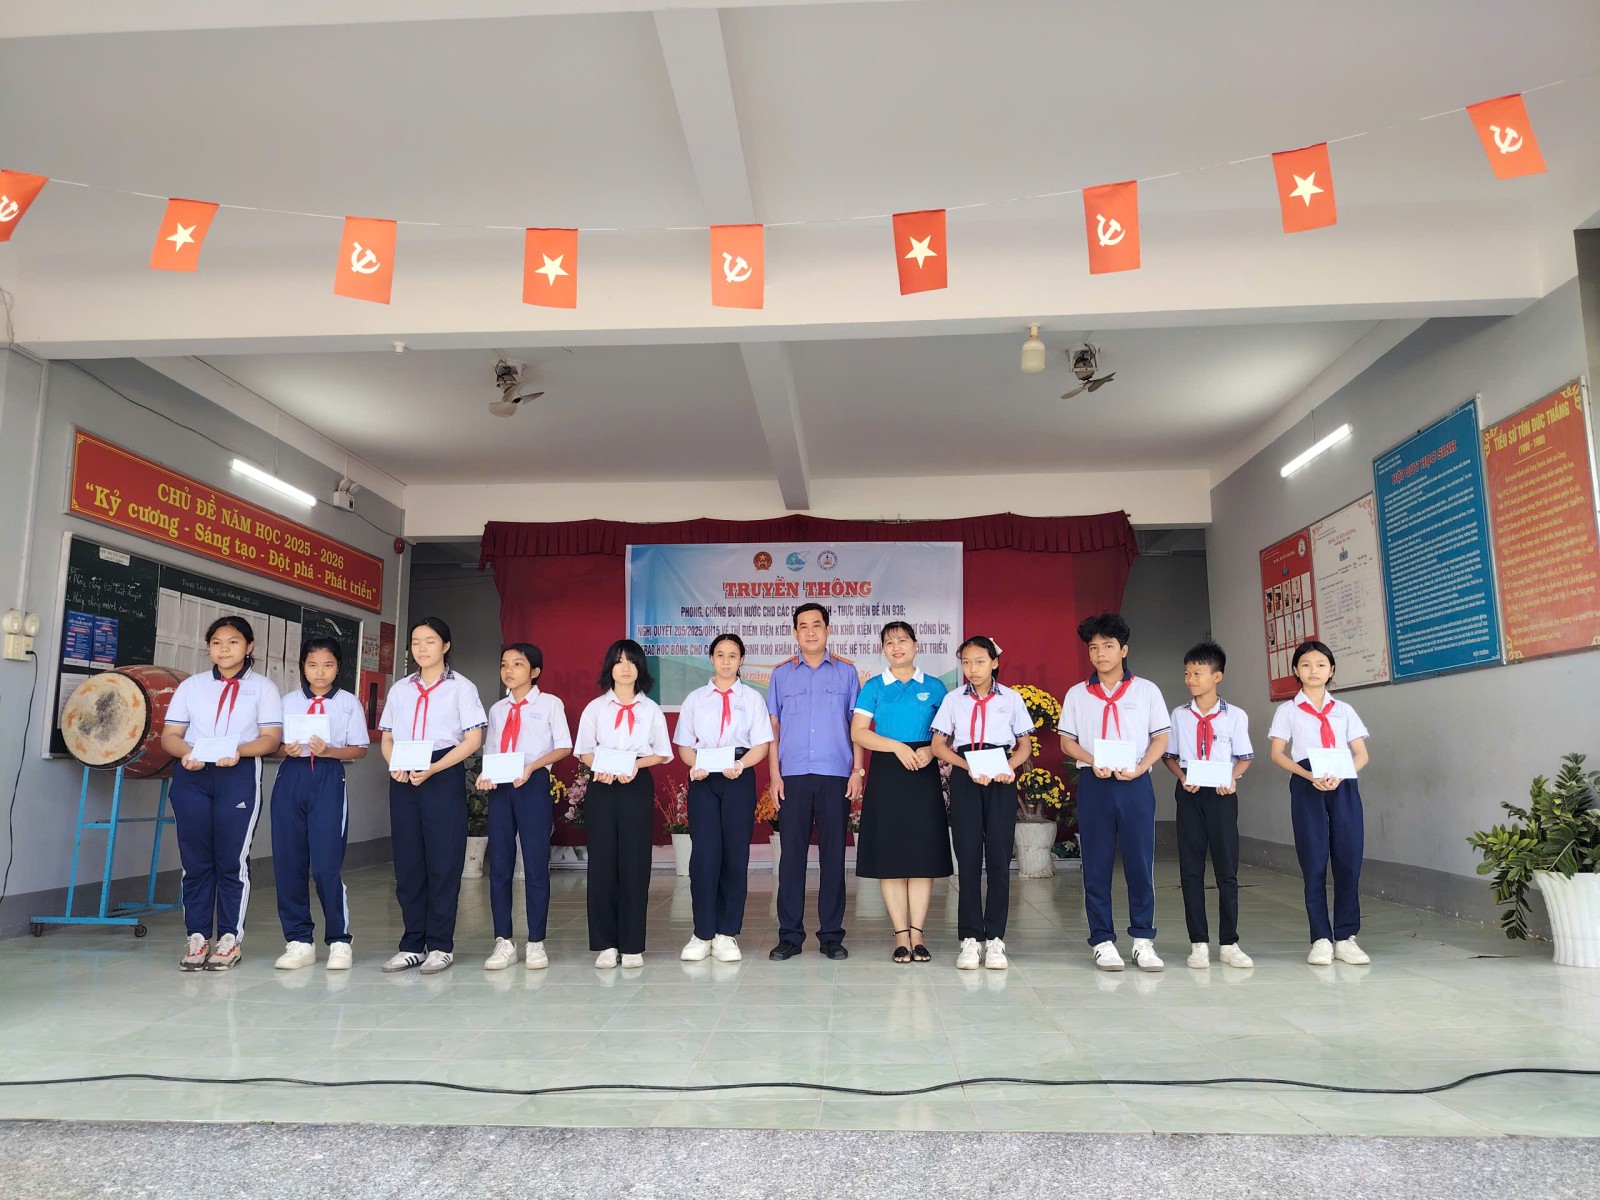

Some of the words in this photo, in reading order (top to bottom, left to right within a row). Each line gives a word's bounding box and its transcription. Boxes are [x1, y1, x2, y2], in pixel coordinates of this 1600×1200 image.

[1494, 430, 1508, 452] TIỂU
[1508, 424, 1517, 445] SỬ
[1518, 420, 1531, 440] TÔN
[1531, 413, 1546, 432] ĐỨC
[1546, 400, 1570, 425] THẮNG
[1405, 460, 1420, 478] QUY
[1420, 451, 1436, 468] HỌC
[1437, 440, 1457, 460] SINH
[157, 483, 192, 510] CHỦ
[196, 494, 217, 520] ĐỀ
[221, 508, 252, 534] NĂM
[254, 522, 281, 544] HỌC
[284, 534, 311, 556] 2025
[320, 548, 344, 570] 2026
[128, 503, 180, 538] cương
[194, 522, 231, 556] Sáng
[235, 538, 257, 560] tạo
[268, 549, 291, 572] Đột
[294, 562, 314, 580] phá
[324, 570, 347, 592] Phát
[723, 576, 800, 598] TRUYỀN
[803, 578, 872, 598] THÔNG
[681, 604, 704, 618] PHÒNG,
[706, 602, 726, 618] CHỐNG
[728, 603, 742, 618] ĐUỐI
[744, 604, 762, 618] NƯỚC
[763, 606, 776, 617] CHO
[777, 604, 790, 617] CÁC
[838, 605, 854, 619] THỰC
[856, 603, 870, 619] HIỆN
[882, 603, 890, 616] ÁN
[892, 604, 906, 617] 938;
[638, 625, 652, 639] NGHỊ
[654, 621, 672, 638] QUYẾT
[674, 625, 720, 637] 205/2025/QH15
[742, 621, 758, 636] ĐIỂM
[760, 623, 774, 638] VIỆN
[776, 621, 792, 636] KIỂM
[840, 621, 855, 636] KHỞI
[857, 622, 872, 638] KIỆN
[920, 622, 937, 635] CÔNG
[938, 621, 951, 636] ÍCH;
[656, 645, 670, 658] HỌC
[671, 642, 688, 656] BỔNG
[690, 645, 702, 656] CHO
[744, 644, 758, 656] SINH
[760, 642, 773, 656] KHÓ
[774, 642, 792, 656] KHĂN
[836, 640, 848, 654] THẾ
[850, 642, 858, 656] HỆ
[860, 640, 870, 654] TRẺ
[930, 638, 948, 654] TRIỂN
